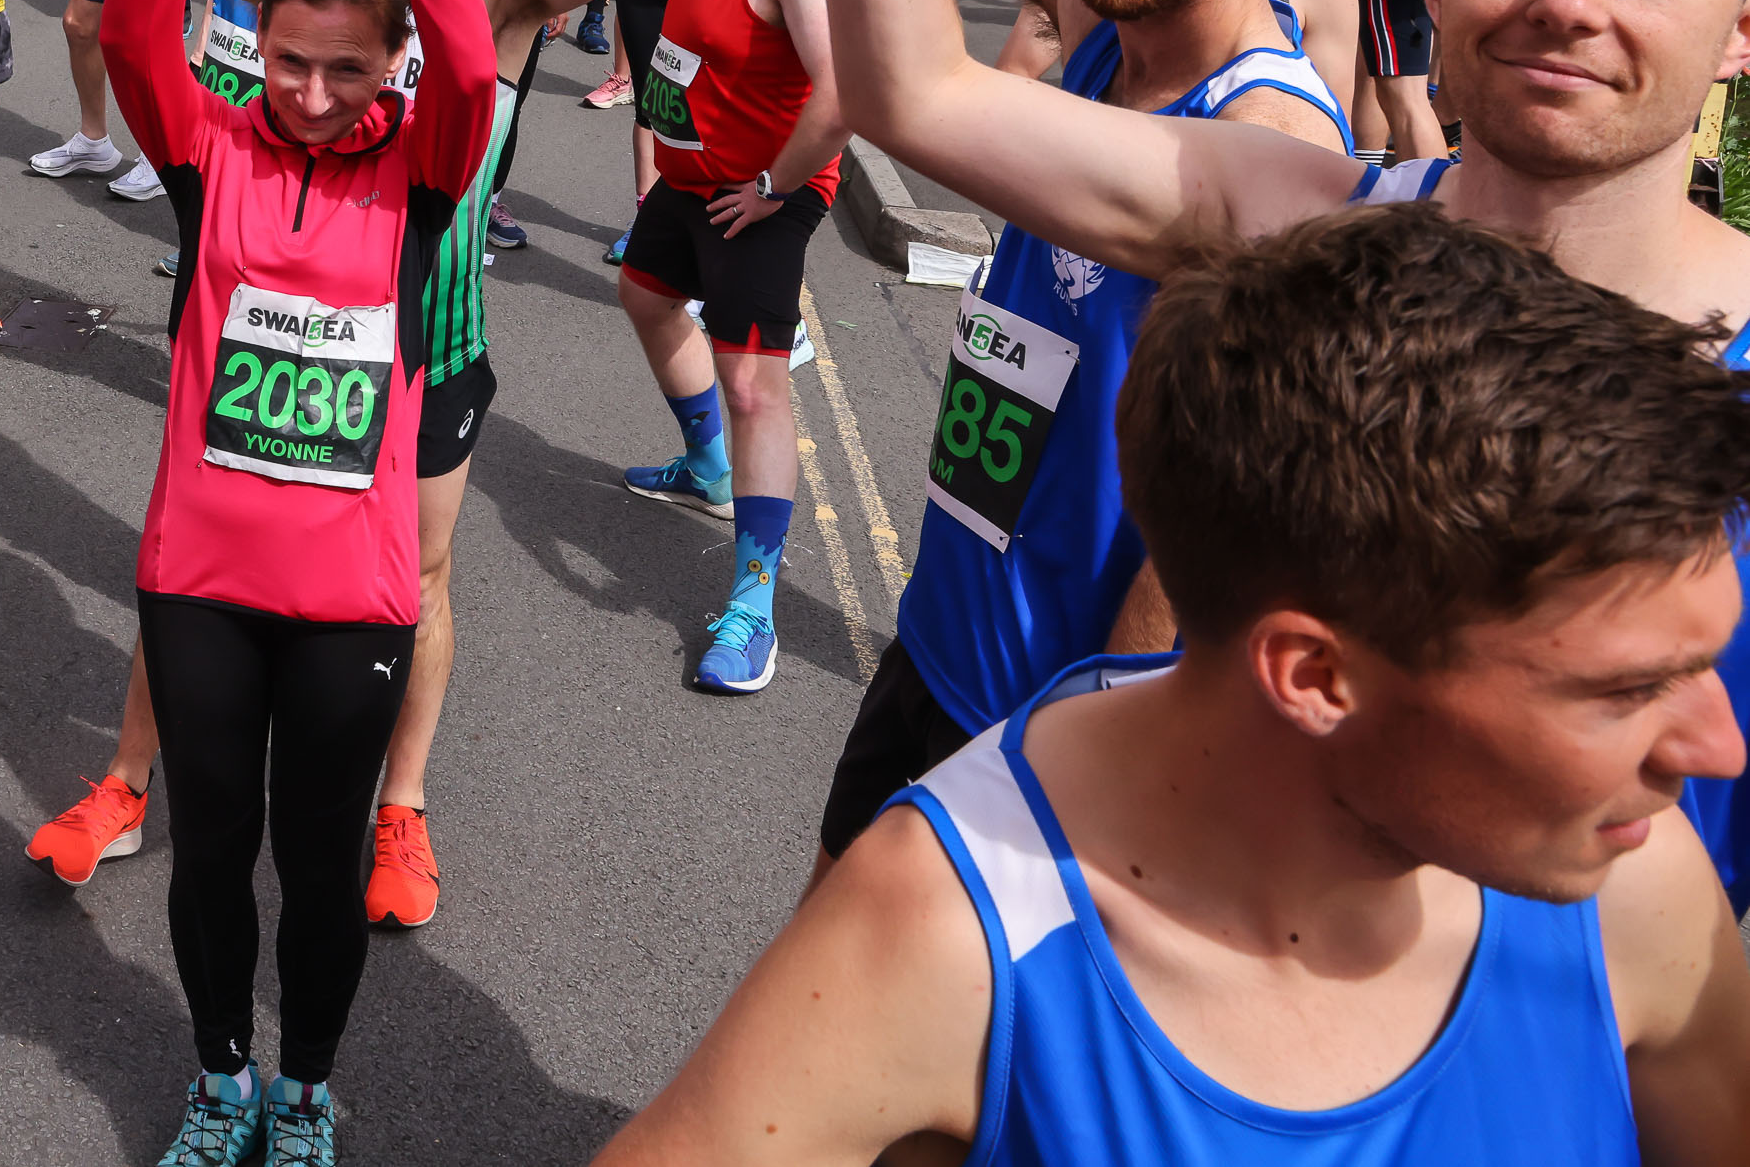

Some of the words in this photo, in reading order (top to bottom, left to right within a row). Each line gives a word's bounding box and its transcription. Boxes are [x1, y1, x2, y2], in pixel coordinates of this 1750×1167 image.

[641, 71, 687, 124] 2105
[213, 350, 375, 441] 2030
[941, 378, 1033, 483] 85
[244, 431, 334, 464] YVONNE
